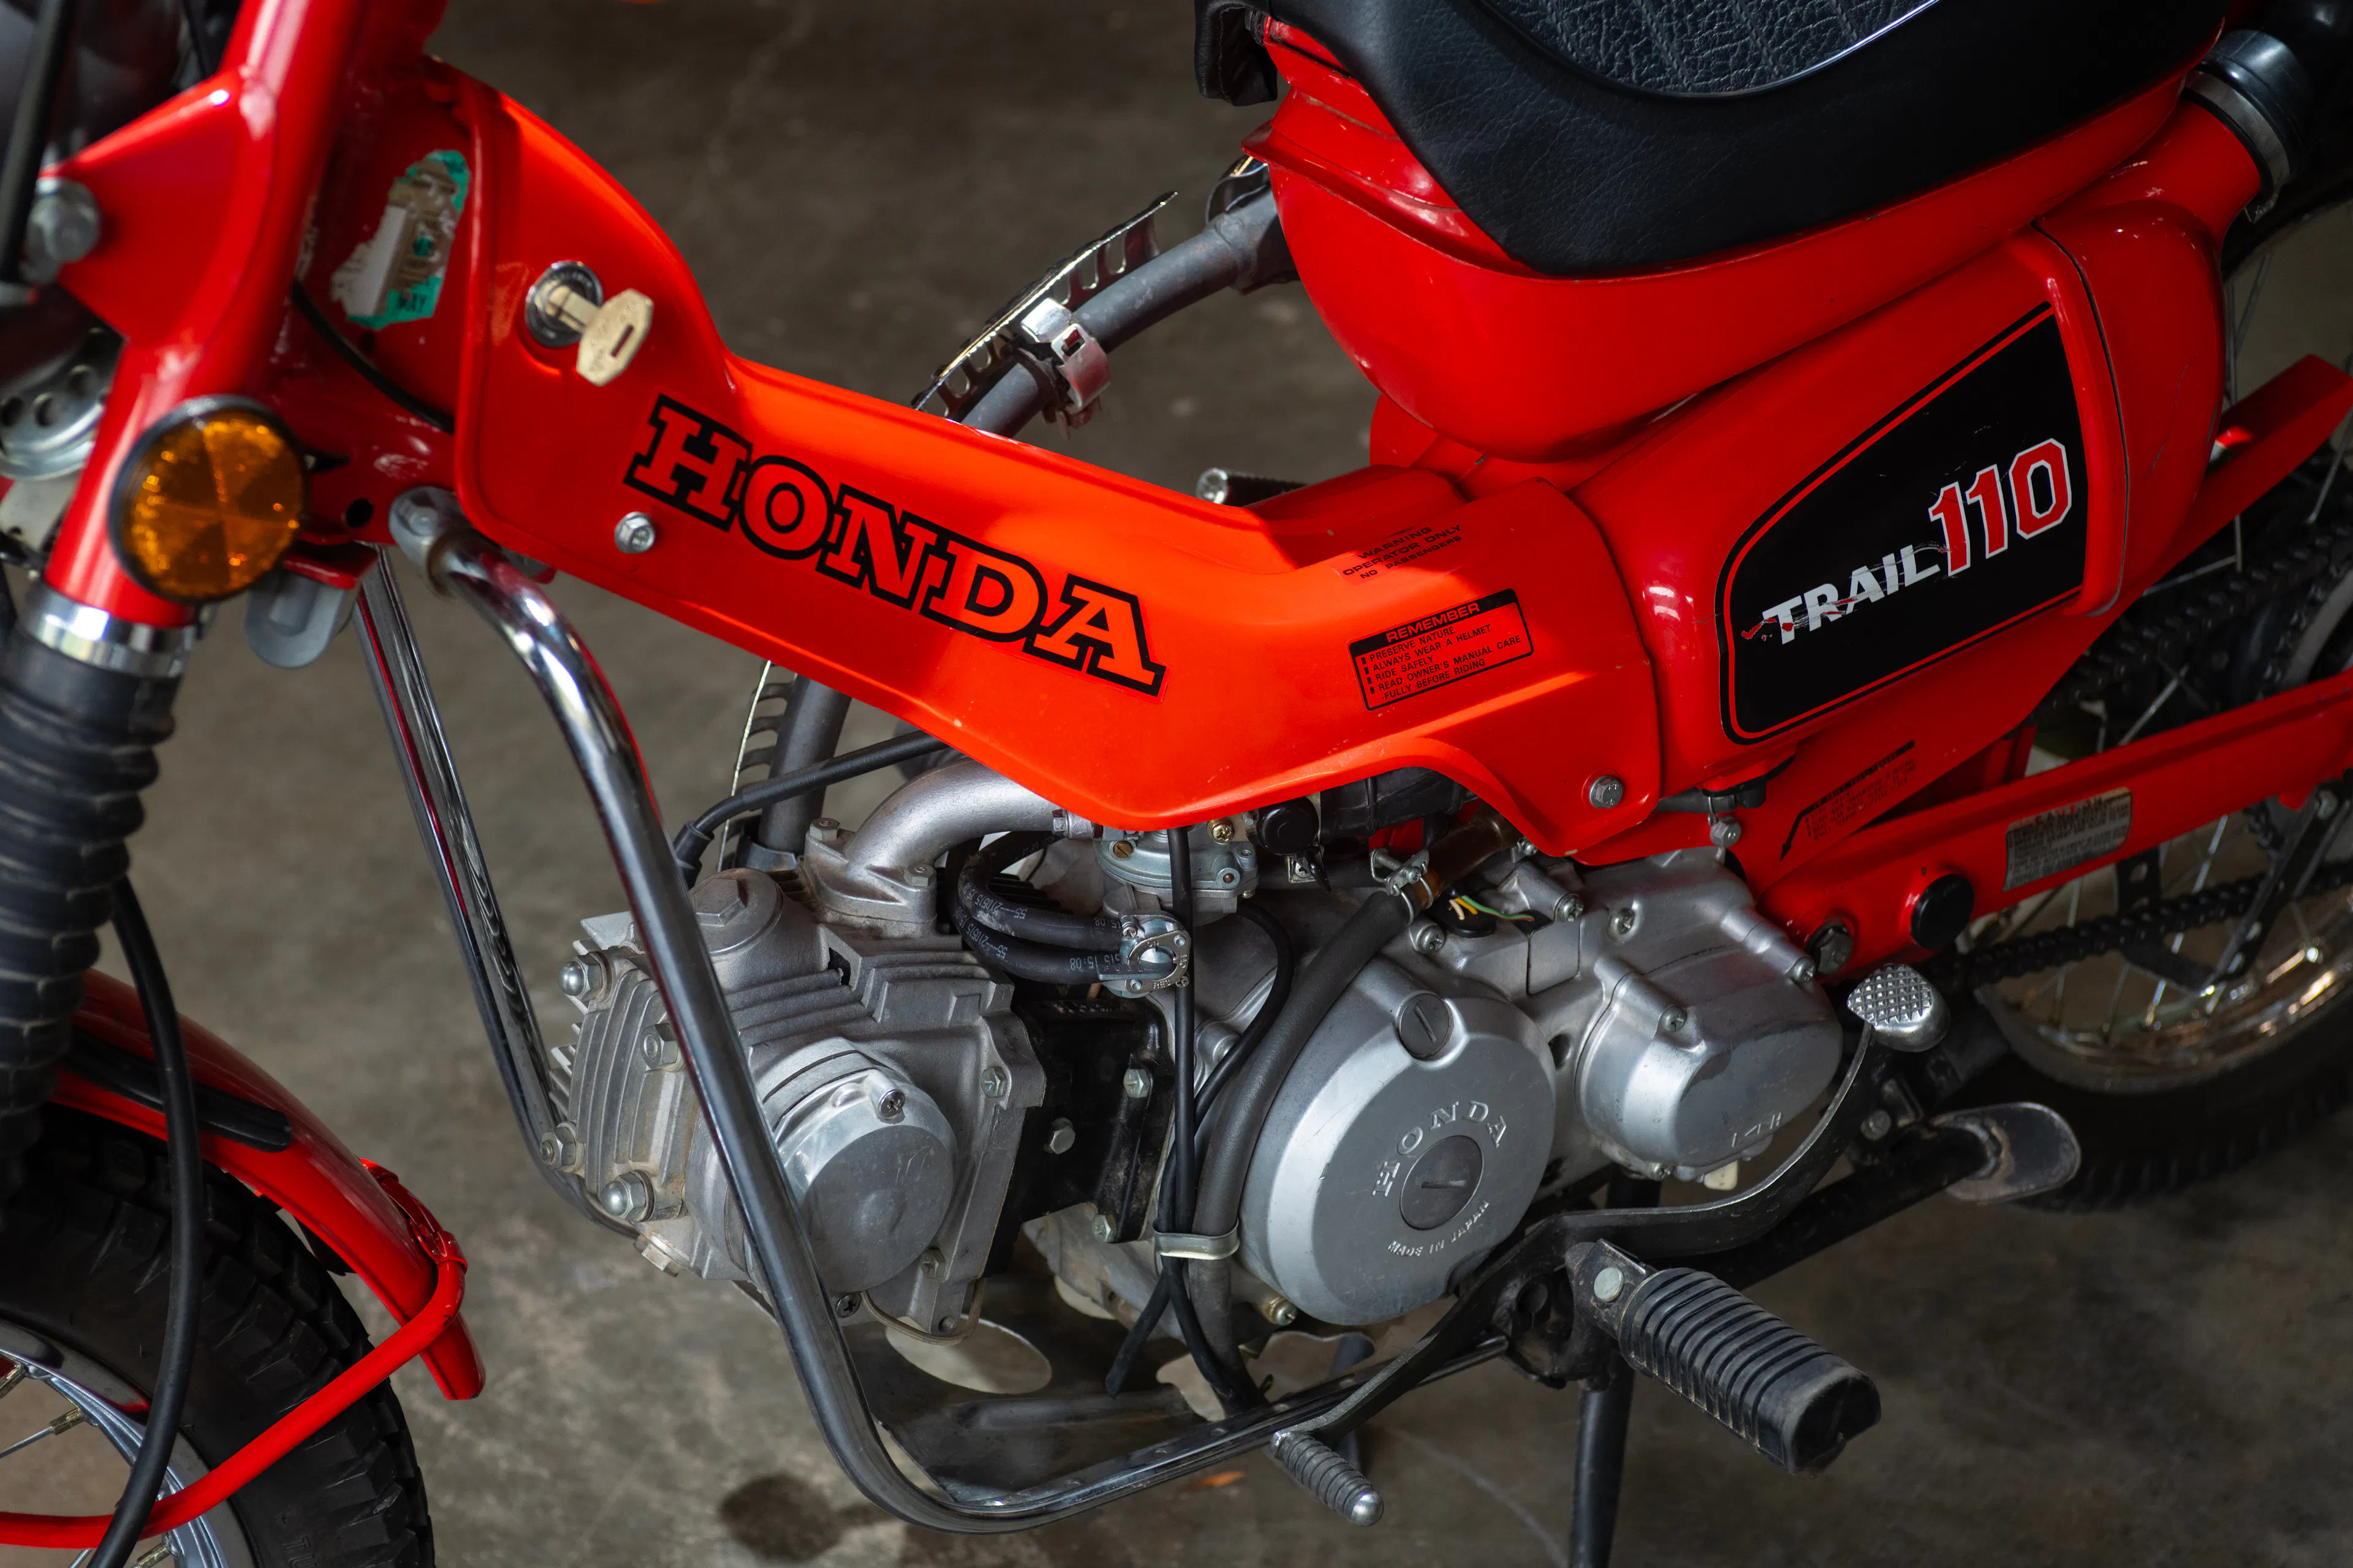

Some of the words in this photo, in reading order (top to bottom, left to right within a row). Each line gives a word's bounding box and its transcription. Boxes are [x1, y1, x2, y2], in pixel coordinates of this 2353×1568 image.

[623, 393, 1167, 697] HONDA
[1343, 542, 1421, 576] OPERATOR
[1424, 524, 1461, 543] ONLY
[1357, 526, 1432, 559] WARNING
[1360, 569, 1378, 579] NO
[1385, 536, 1462, 569] PASSENGERS
[1762, 545, 1941, 645] TRAIL
[1928, 437, 2072, 577] 110
[1370, 640, 1416, 662] PRESERVE
[1419, 626, 1455, 645] NATURE
[1385, 602, 1480, 643] REMEMBER
[1373, 653, 1411, 672] ALWAYS
[1414, 642, 1442, 657] WEAR
[1456, 624, 1491, 643] HELMET
[1375, 668, 1397, 681] RIDE
[1401, 655, 1433, 673] SAFELY
[1378, 676, 1403, 692] READ
[1407, 661, 1449, 681] OWNER'S
[1453, 646, 1493, 665] MANUAL
[1496, 635, 1521, 650] CARE
[1416, 670, 1450, 689] BEFORE
[1453, 659, 1486, 676] RIDING
[1371, 1100, 1507, 1197] HONDA
[1387, 1240, 1424, 1257] MADE
[1429, 1239, 1445, 1254] IN
[1450, 1200, 1490, 1243] JAPAN
